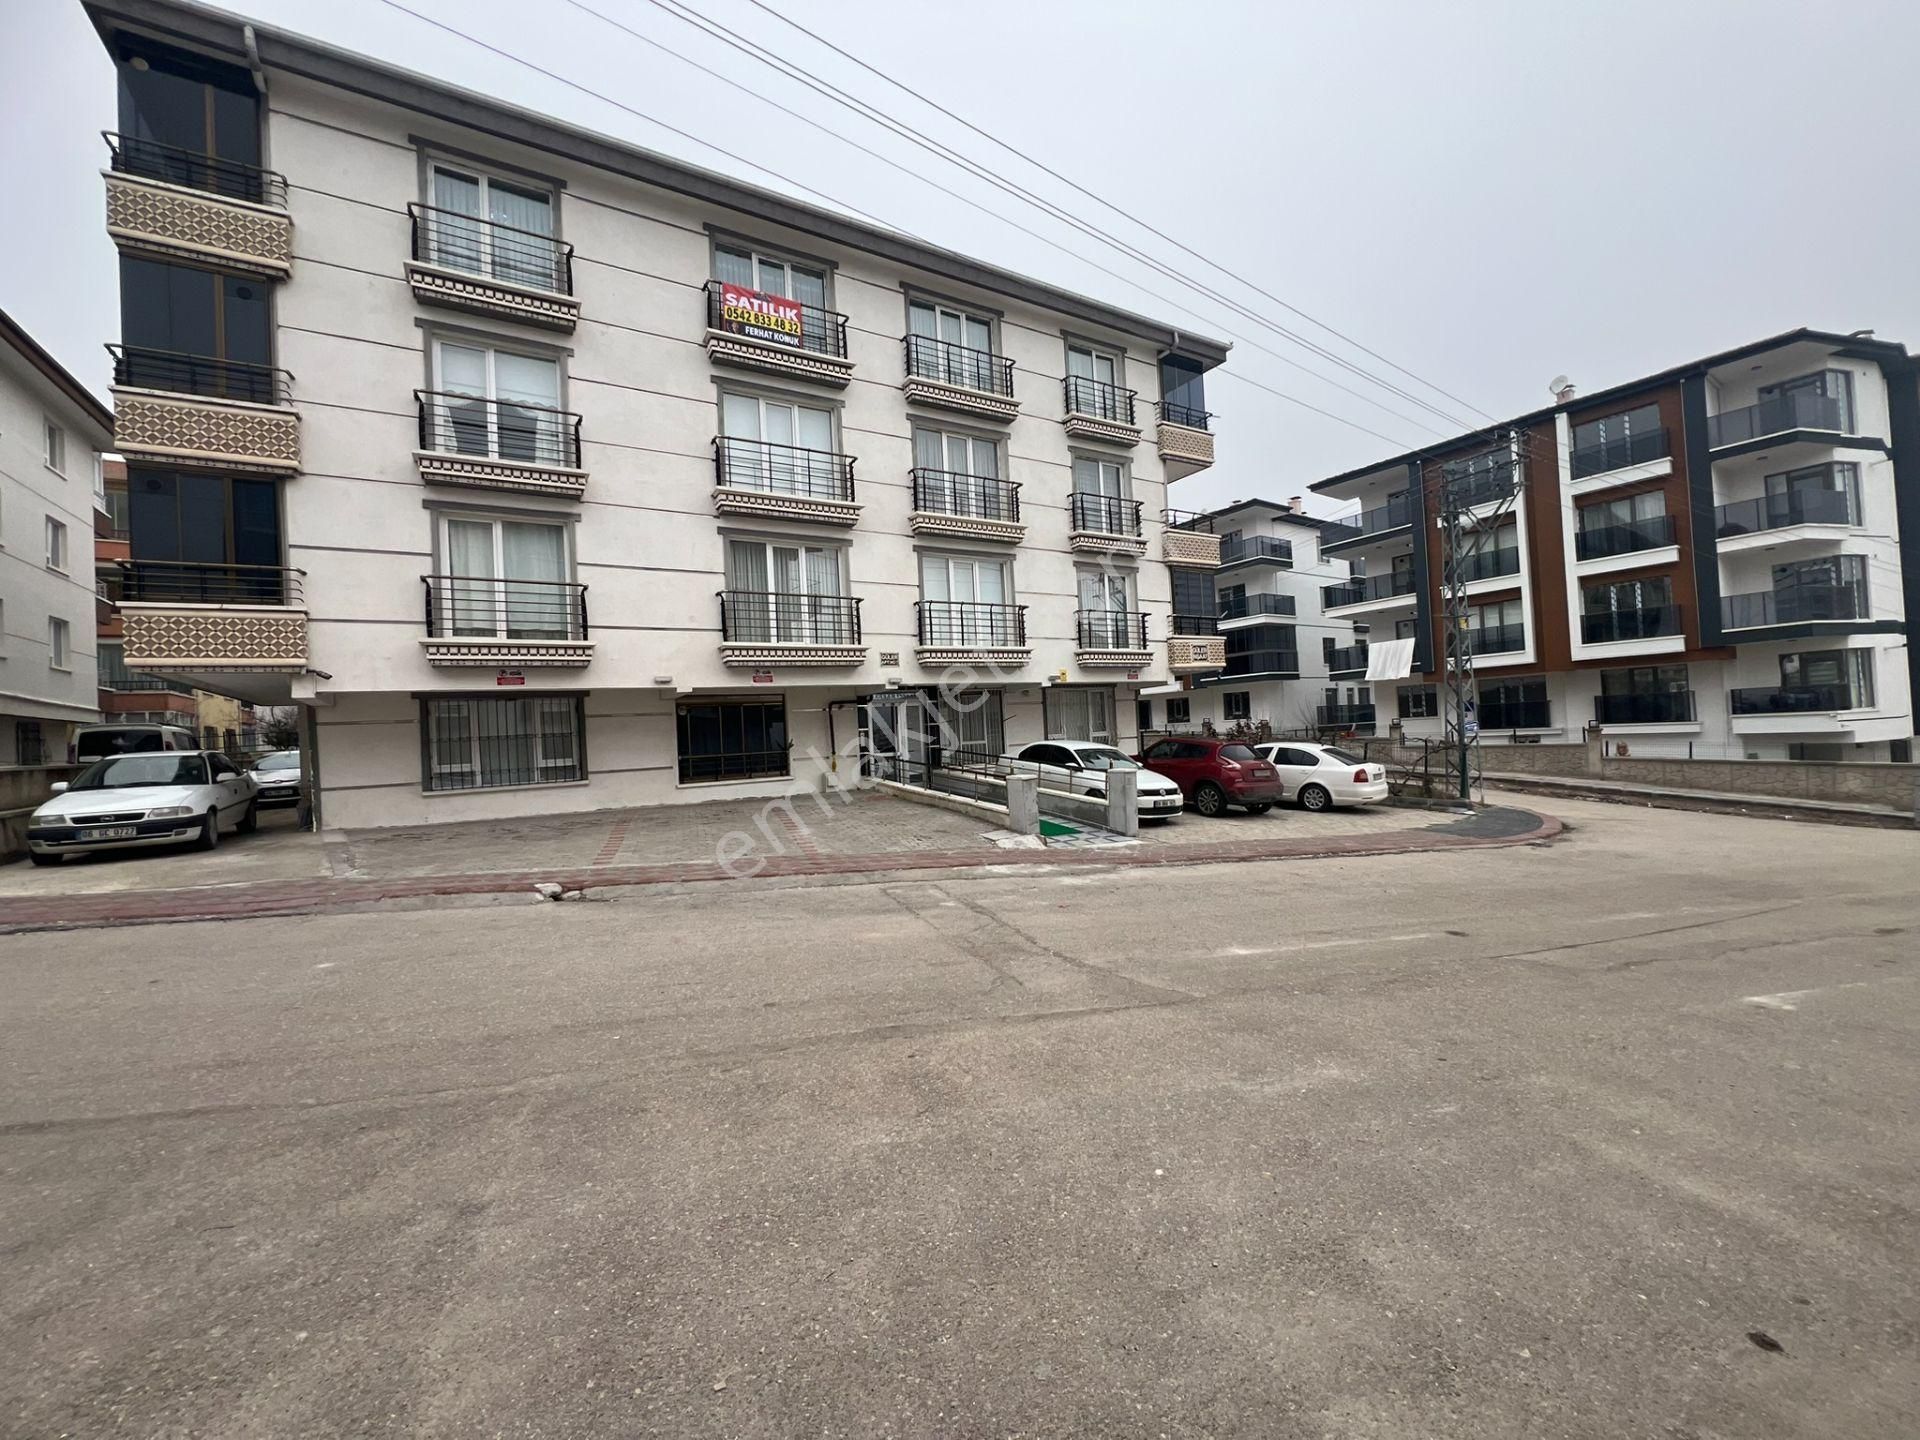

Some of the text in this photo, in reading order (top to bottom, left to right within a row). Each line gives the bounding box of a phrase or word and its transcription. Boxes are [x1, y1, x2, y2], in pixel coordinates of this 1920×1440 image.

[725, 292, 799, 322] SATILIK
[726, 307, 752, 323] 0542
[754, 313, 772, 328] 833
[788, 322, 799, 334] 32
[745, 326, 800, 346] FERHAT KONUK
